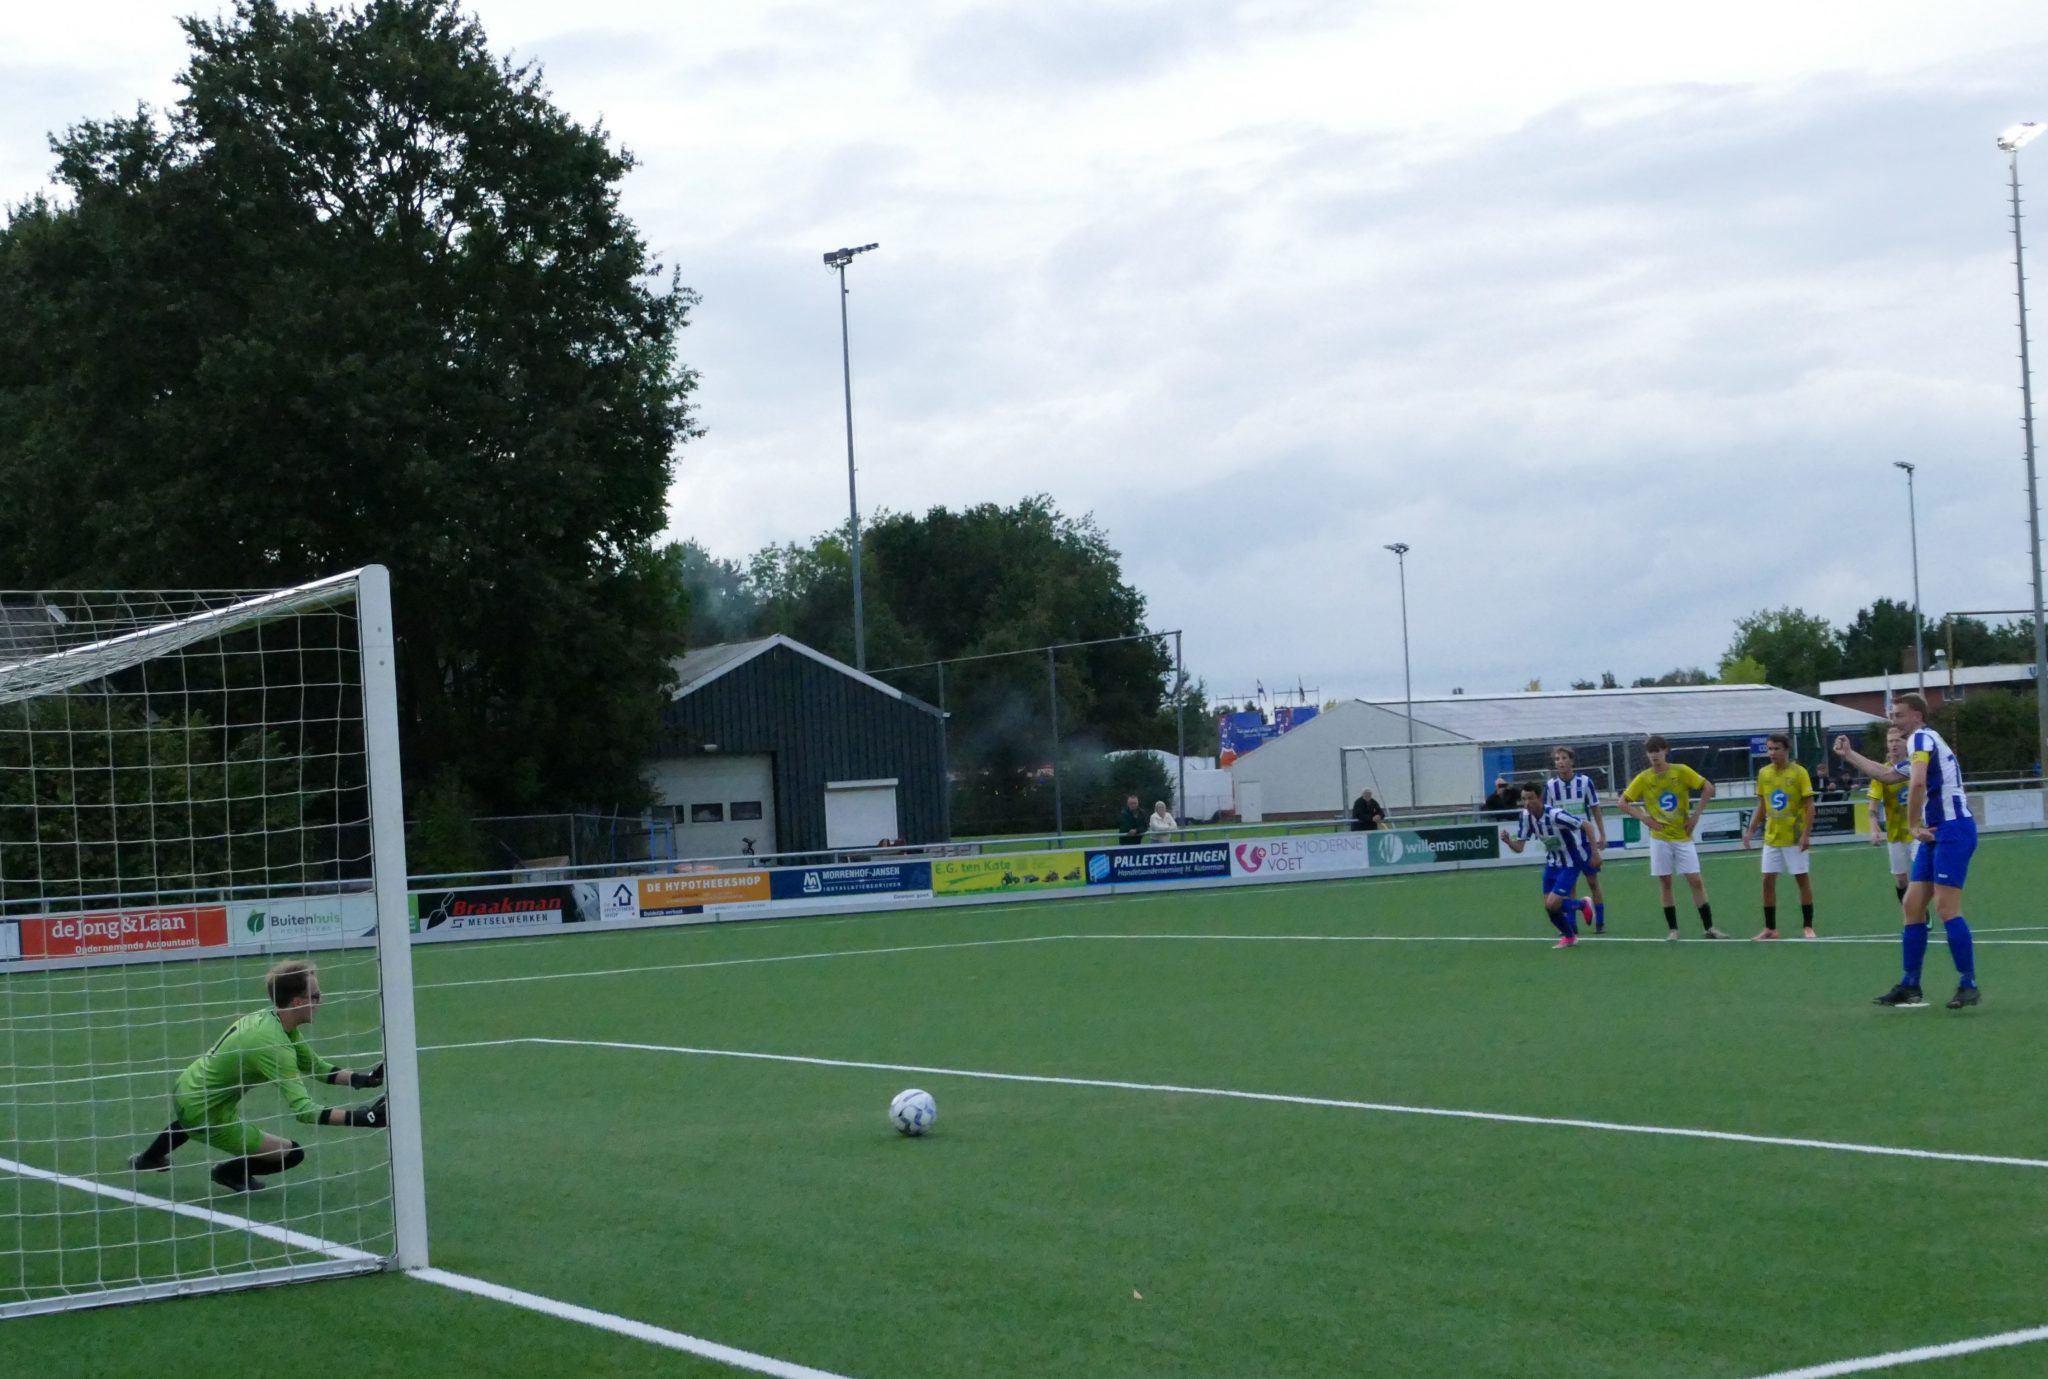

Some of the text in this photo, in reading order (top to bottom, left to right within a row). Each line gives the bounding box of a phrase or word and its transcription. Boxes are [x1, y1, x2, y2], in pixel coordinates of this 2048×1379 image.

[1270, 837, 1363, 856] DE MODERNE
[1405, 836, 1489, 854] willemsmode
[961, 862, 980, 872] ten
[983, 860, 1011, 871] Kate
[1113, 850, 1228, 868] PALLETSTELLINGEN
[1268, 857, 1304, 871] VOET
[822, 866, 901, 880] MORRENHOF-JANSEN
[646, 877, 762, 893] DE HYPOTHEEKSHOP
[451, 897, 561, 916] Braakman
[270, 911, 341, 927] Buitenhuis
[468, 913, 548, 926] METSELWERKEN
[75, 938, 200, 954] Ondernemende Accountants
